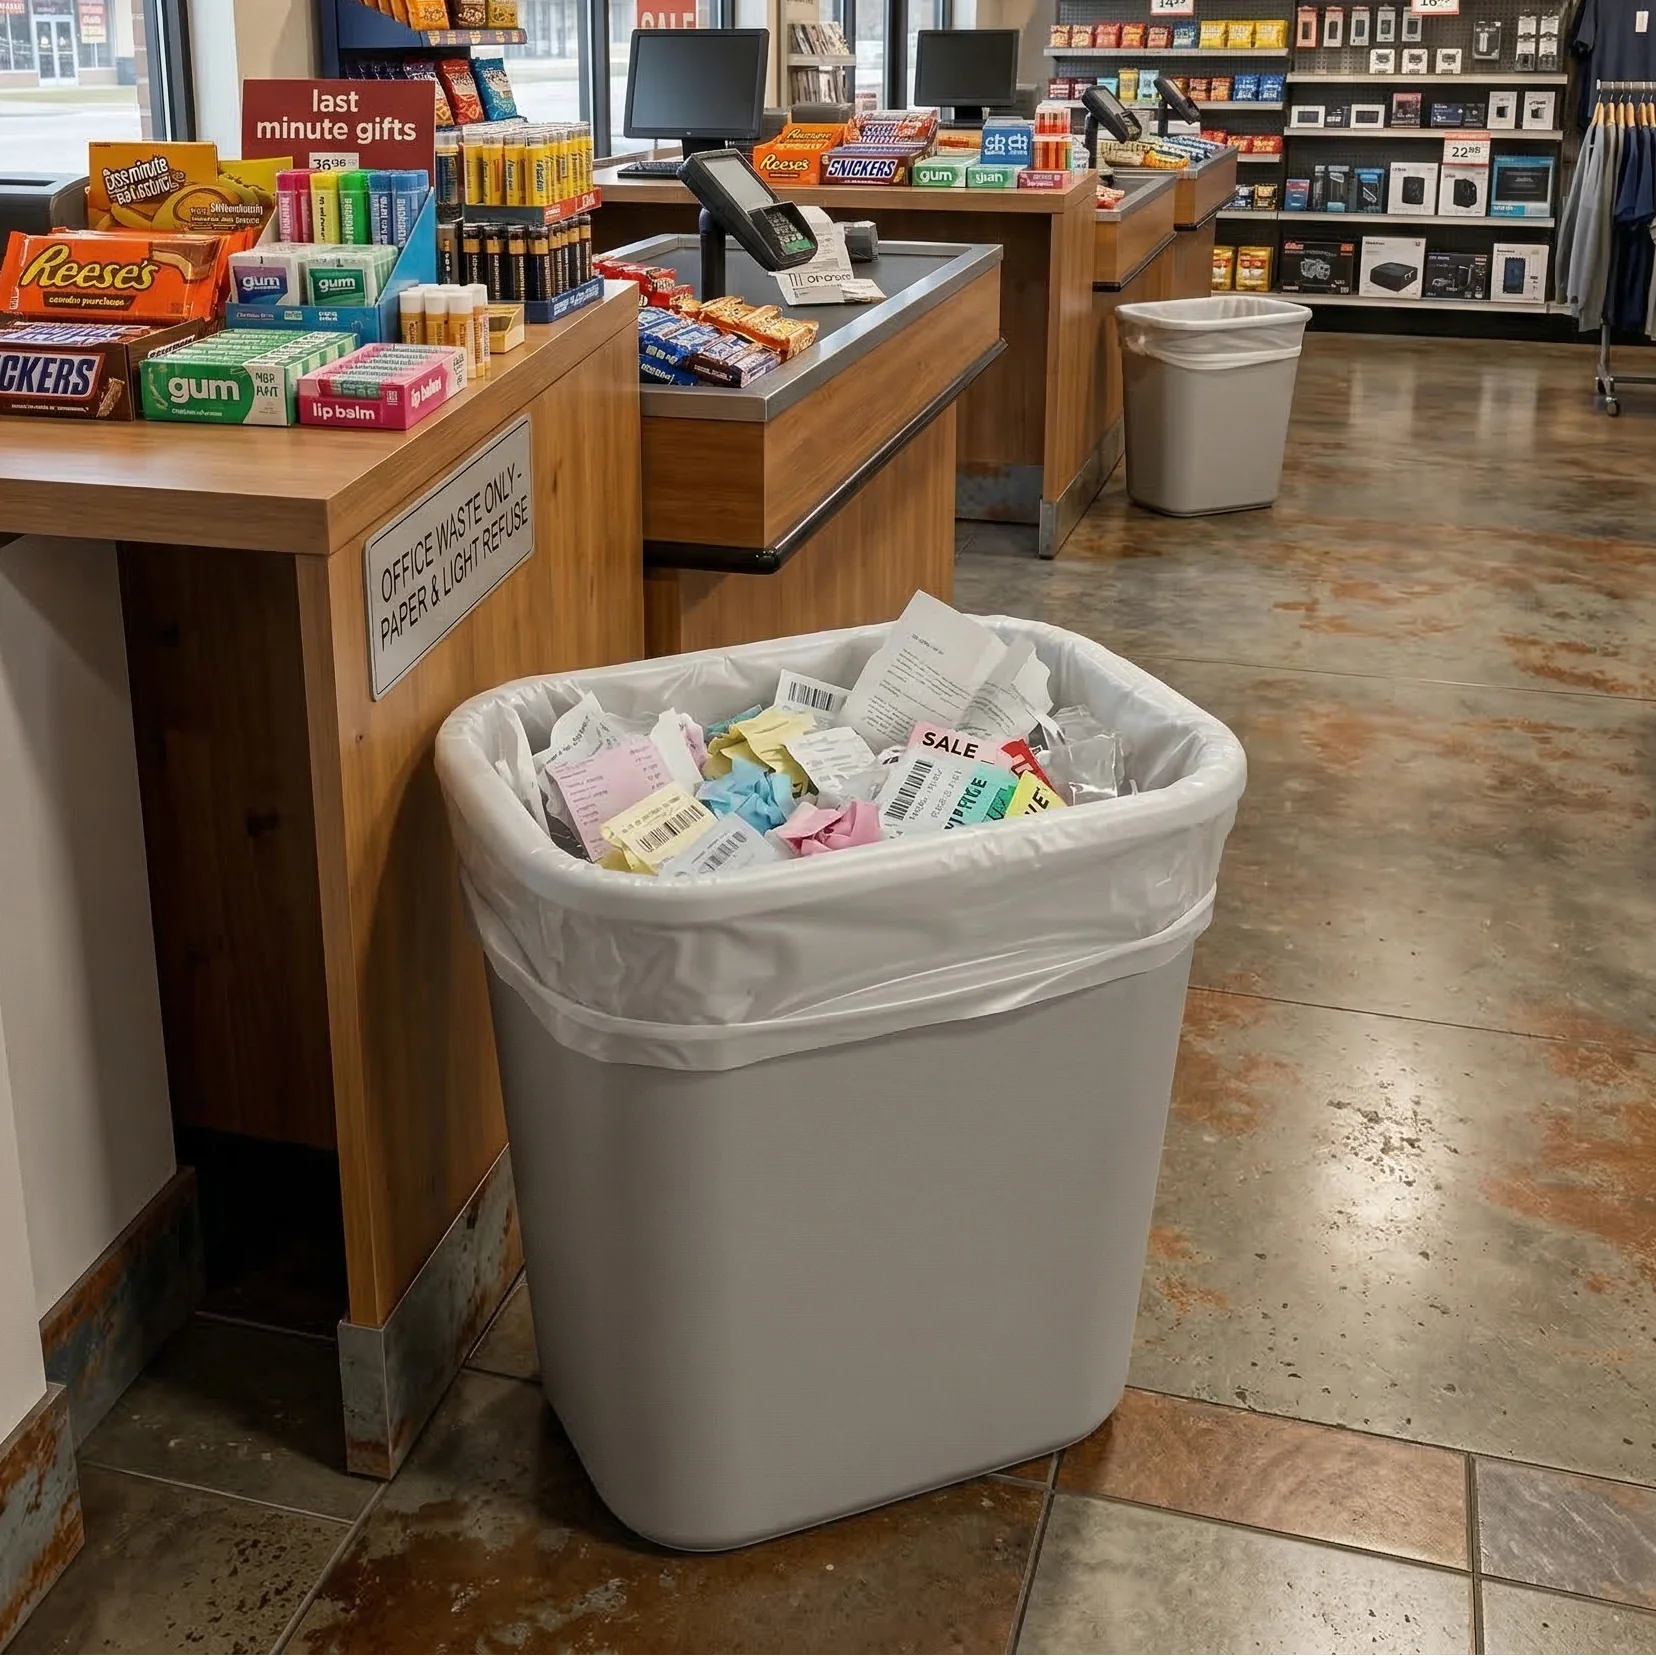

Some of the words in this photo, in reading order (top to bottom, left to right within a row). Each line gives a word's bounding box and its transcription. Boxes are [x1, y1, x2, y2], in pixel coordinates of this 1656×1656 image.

[312, 88, 359, 113] last
[256, 116, 349, 140] minute
[355, 116, 417, 144] gifts
[760, 153, 810, 171] Reese's
[828, 159, 896, 177] SNICKERS
[920, 170, 953, 183] gum
[20, 244, 160, 290] Reese's
[242, 276, 280, 291] gum
[318, 277, 356, 293] gum
[168, 377, 240, 404] gum
[312, 402, 333, 420] lip
[381, 531, 434, 603] OFFICE
[435, 491, 483, 556] WASTE
[380, 585, 428, 651] PAPER
[431, 574, 441, 607] &
[442, 537, 480, 597] LIGHT
[482, 494, 529, 559] REFUSE
[922, 731, 979, 759] SALE
